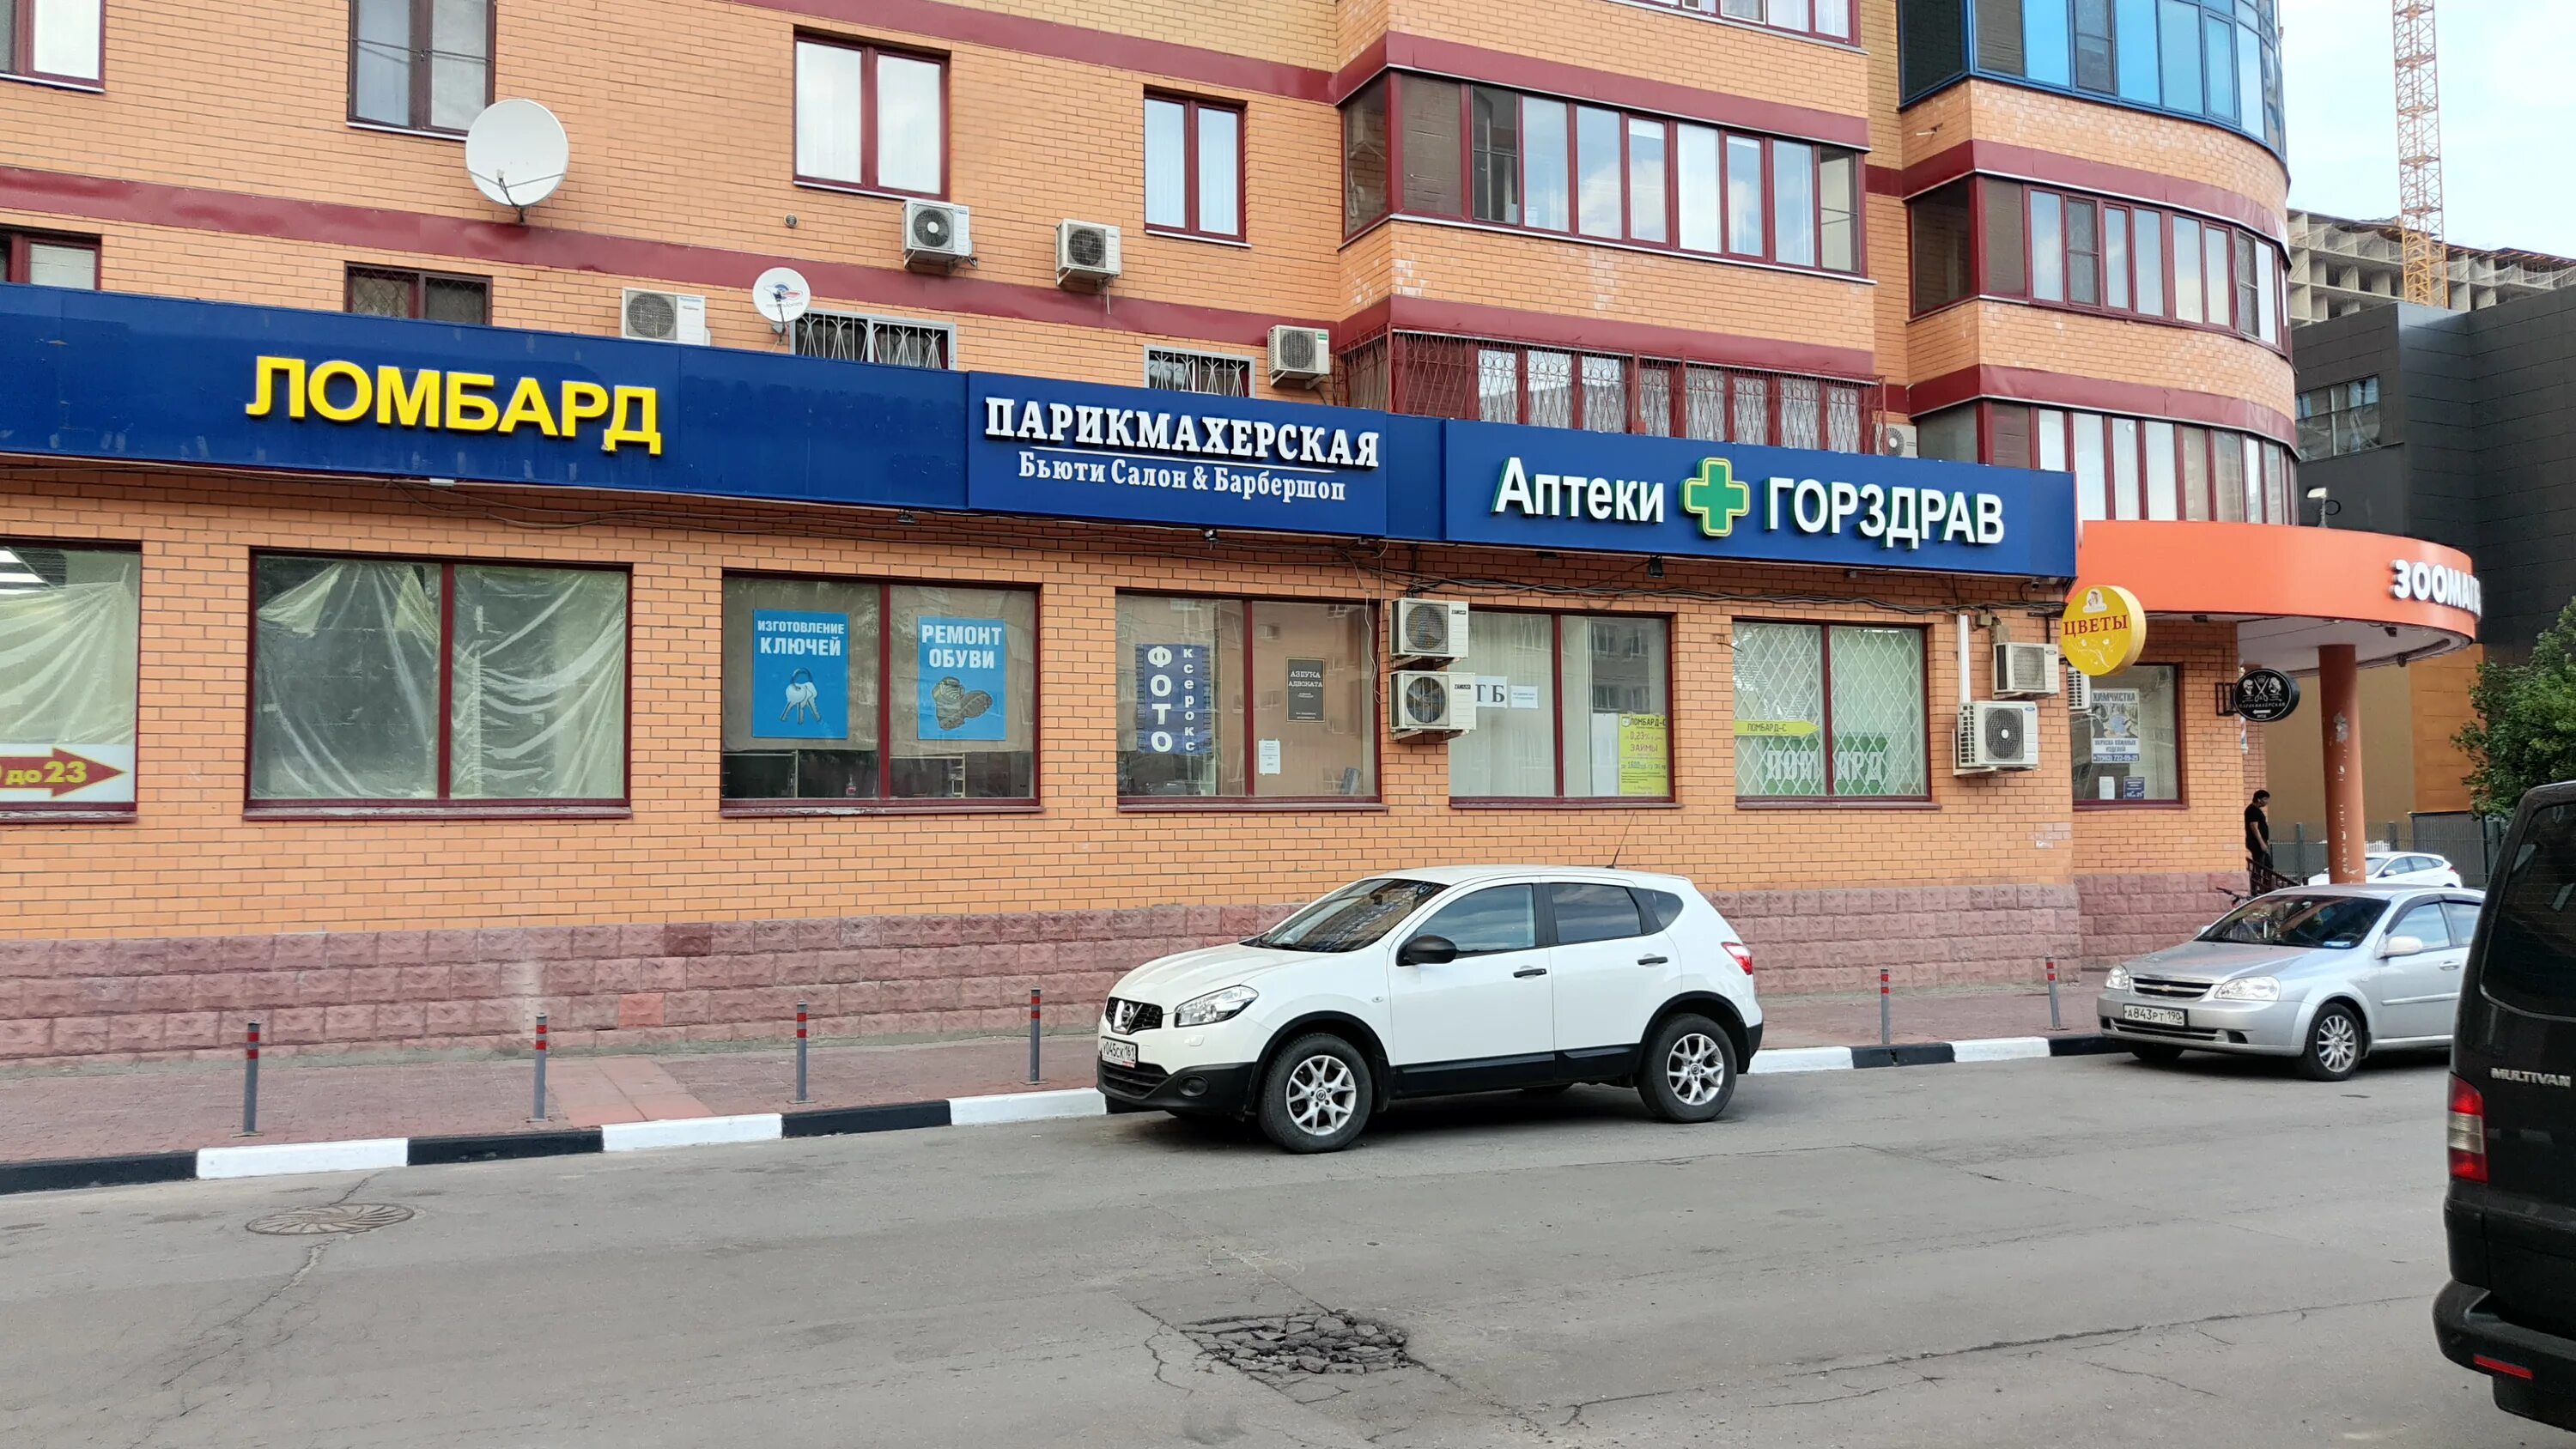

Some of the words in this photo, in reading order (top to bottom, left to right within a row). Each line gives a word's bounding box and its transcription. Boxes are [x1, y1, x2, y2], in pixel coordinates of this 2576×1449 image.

[246, 355, 661, 455] ЛОМБАРД
[985, 397, 1380, 468] ПАРИКМАХЕРСКАЯ
[1019, 451, 1105, 483] Бьюти
[1111, 458, 1187, 490] Салон
[1192, 467, 1208, 490] &
[1213, 468, 1346, 503] Барбершоп
[1493, 457, 1664, 524] Аптеки
[1765, 477, 2005, 549] ГОРЗДРАВ
[757, 620, 845, 635] ИЗГОТОВЛЕНИЕ
[921, 624, 1002, 646] РЕМОНТ
[2063, 615, 2129, 638] ЦВЕТЫ
[760, 636, 841, 657] КЛЮЧЕЙ
[928, 648, 994, 669] ОБУВИ
[1147, 646, 1173, 753] ФОТО
[1747, 723, 1787, 732] ЛОМБАРД-С
[5, 769, 41, 785] до
[44, 761, 87, 783] 23
[2127, 1008, 2165, 1022] А843РТ
[2167, 1010, 2181, 1021] 190
[2491, 1068, 2571, 1088] MULTIVAN
